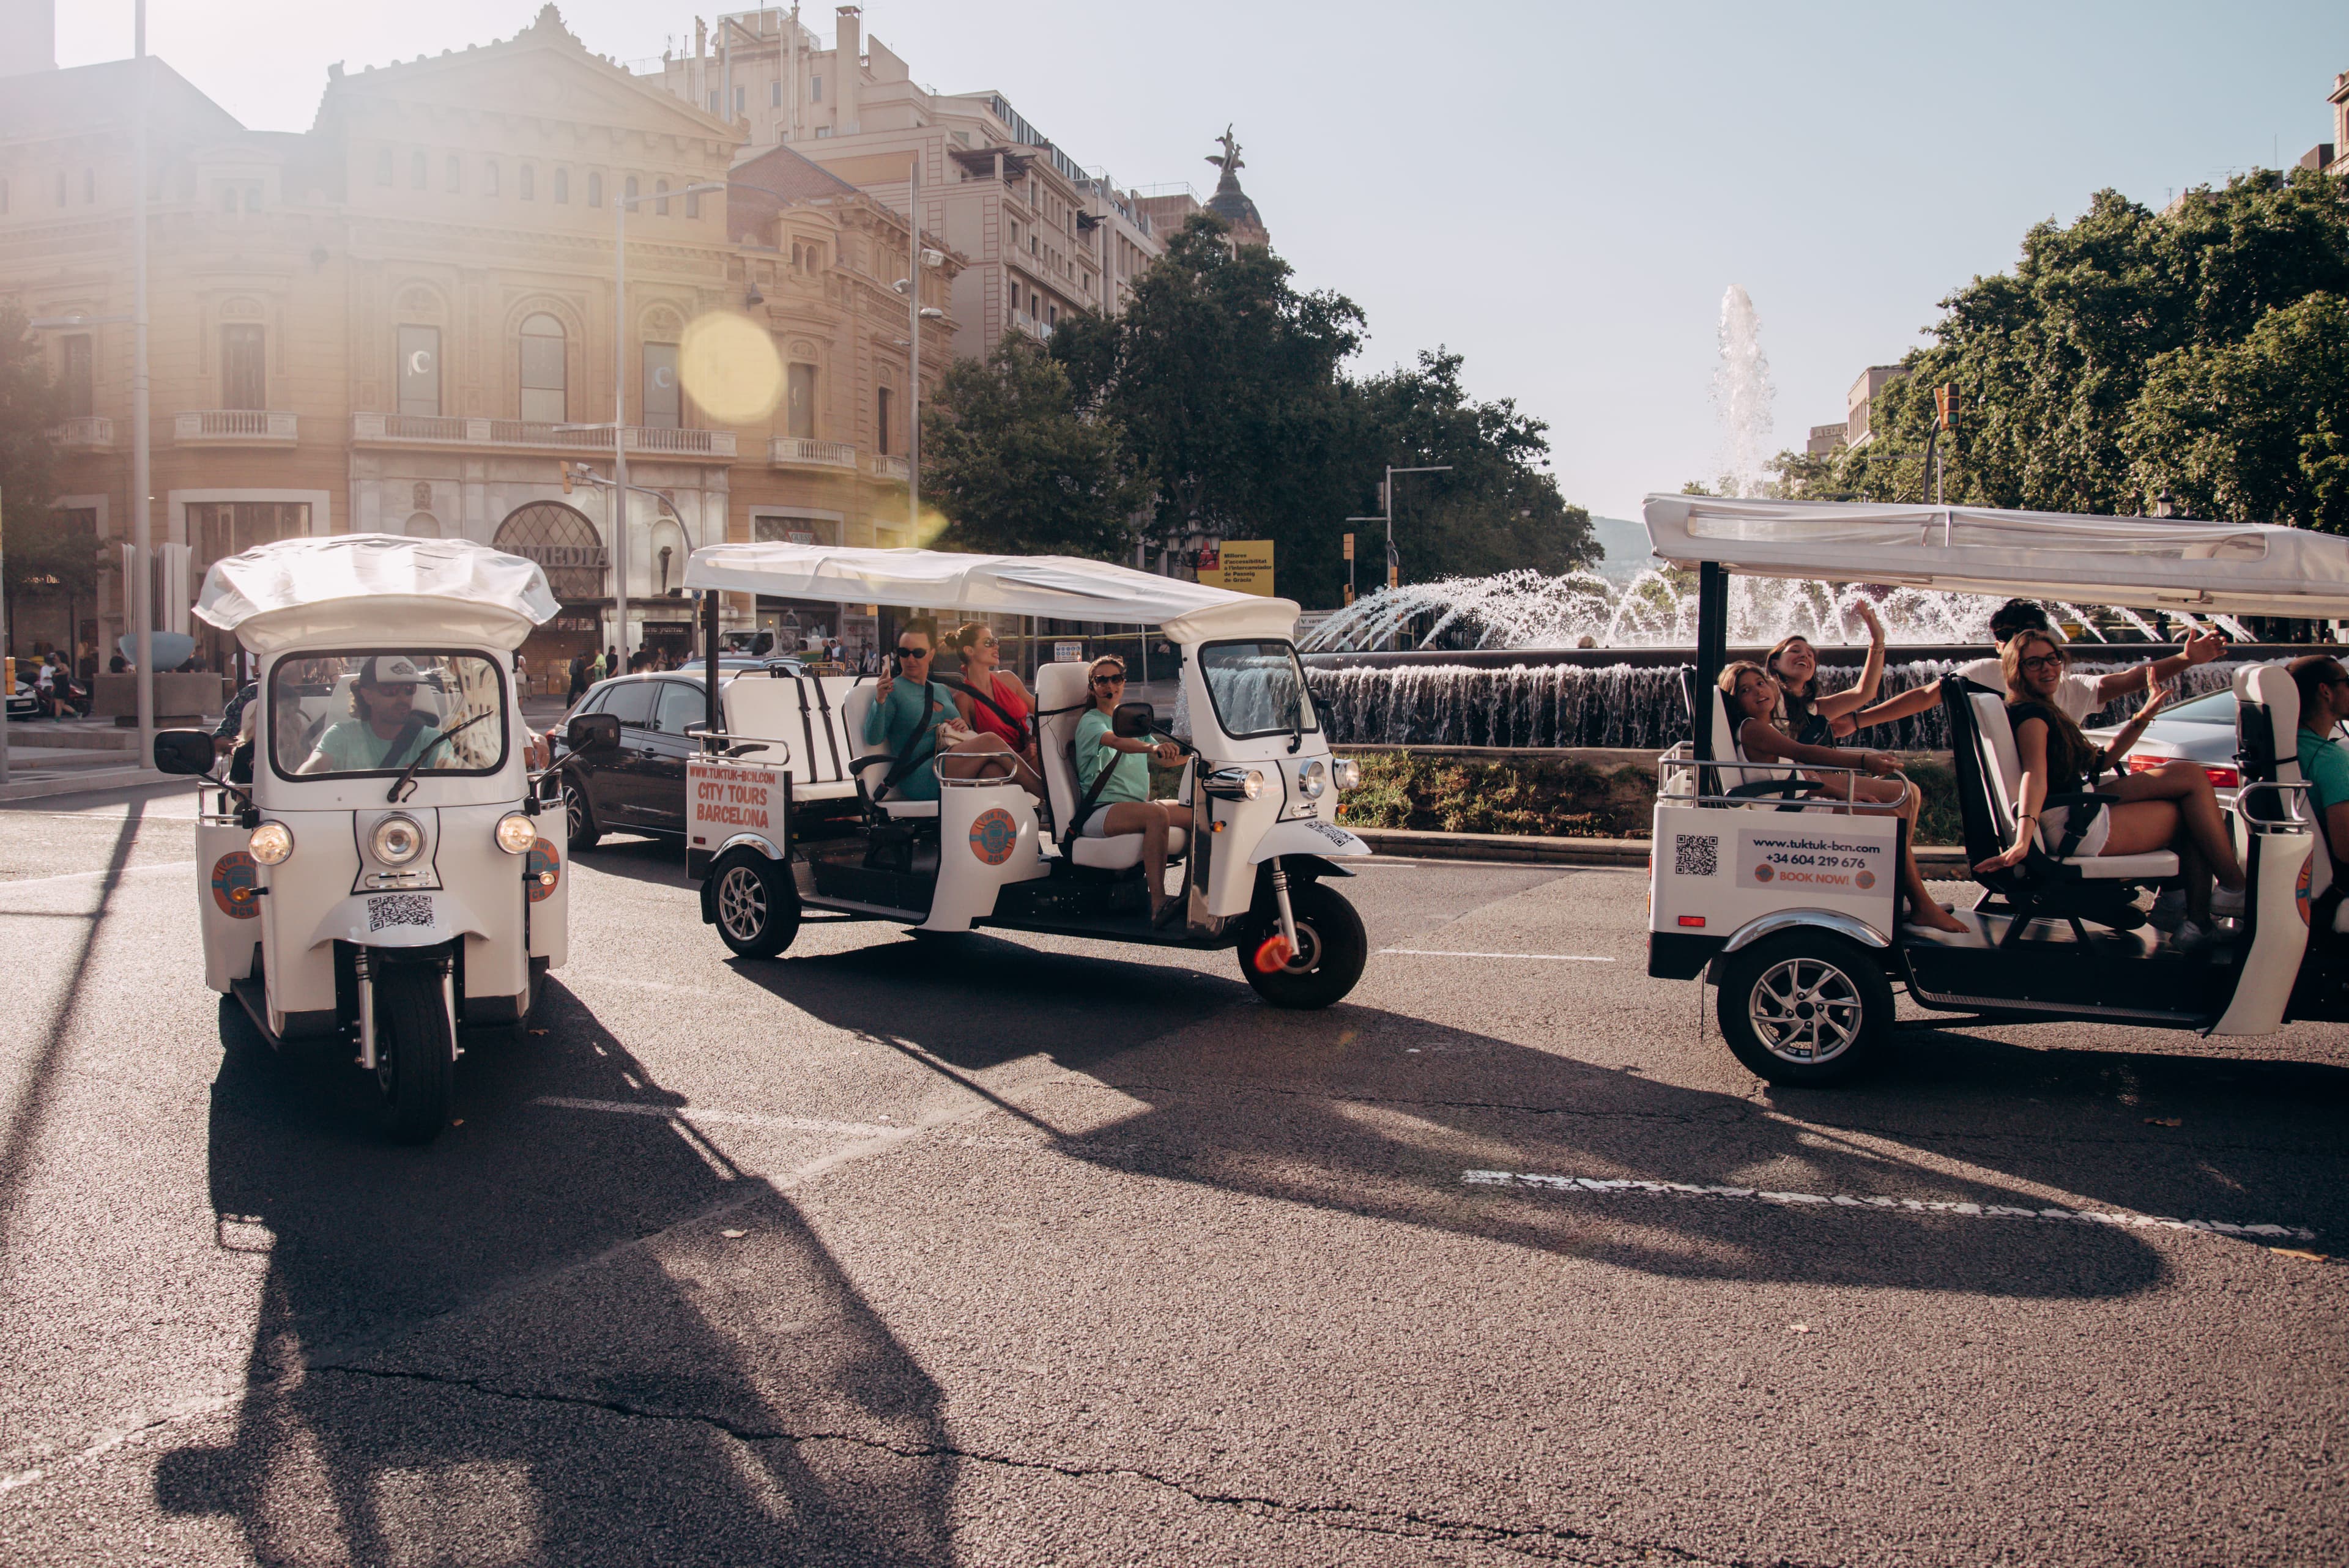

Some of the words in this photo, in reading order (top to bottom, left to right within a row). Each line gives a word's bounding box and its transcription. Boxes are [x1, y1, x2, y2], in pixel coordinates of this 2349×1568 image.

[689, 766, 776, 785] WWW.TUKTUK-BCN.COM
[698, 782, 724, 801] CITY
[728, 785, 768, 806] TOURS
[697, 803, 769, 828] BARCELONA
[1753, 838, 1880, 854] www.tuktuk-bcn.com
[1766, 854, 1788, 864] +34
[1791, 854, 1815, 866] 604
[1818, 856, 1839, 867] 219
[1841, 858, 1866, 869] 676
[1779, 871, 1813, 883] BOOK
[1816, 873, 1850, 886] NOW!
